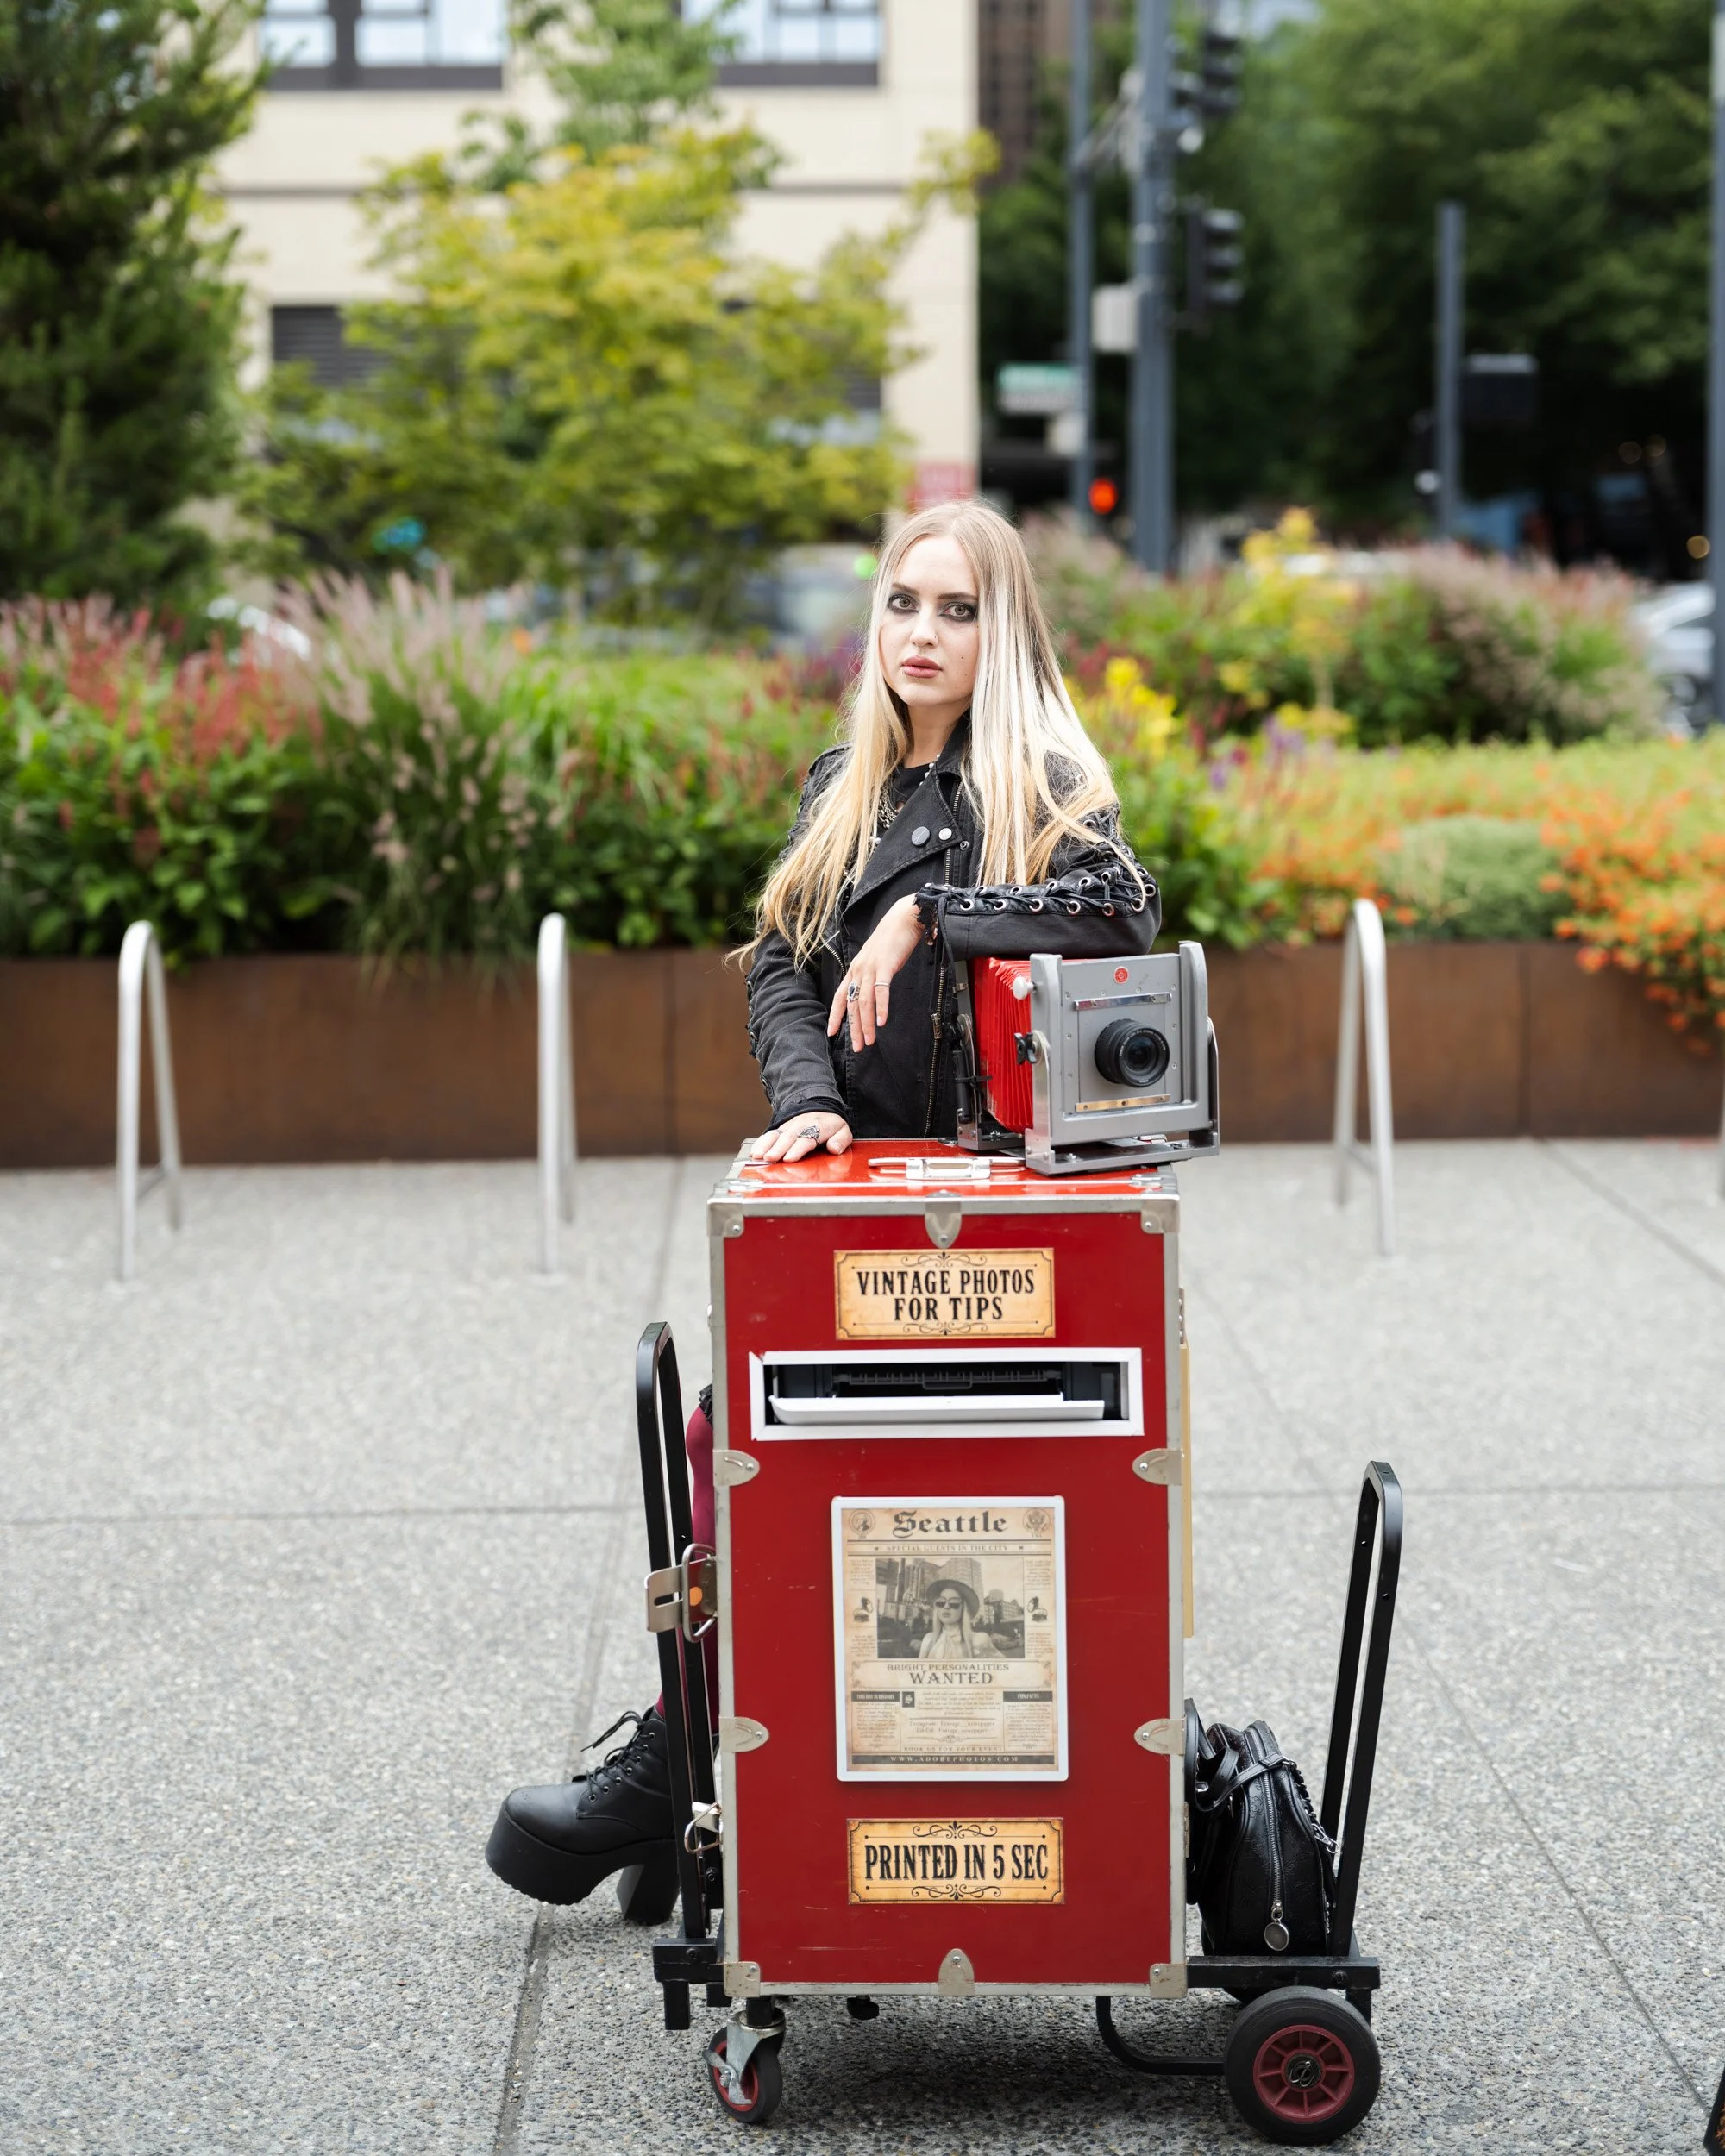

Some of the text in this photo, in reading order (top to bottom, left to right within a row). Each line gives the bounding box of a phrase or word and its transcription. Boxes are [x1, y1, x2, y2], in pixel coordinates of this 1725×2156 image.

[857, 1269, 1035, 1295] VINTAGE PHOTOS
[894, 1296, 1004, 1321] FOR TIPS
[892, 1510, 1008, 1539] Seattle
[910, 1670, 994, 1684] WANTED
[864, 1844, 1048, 1881] PRINTED IN 5 SEC
